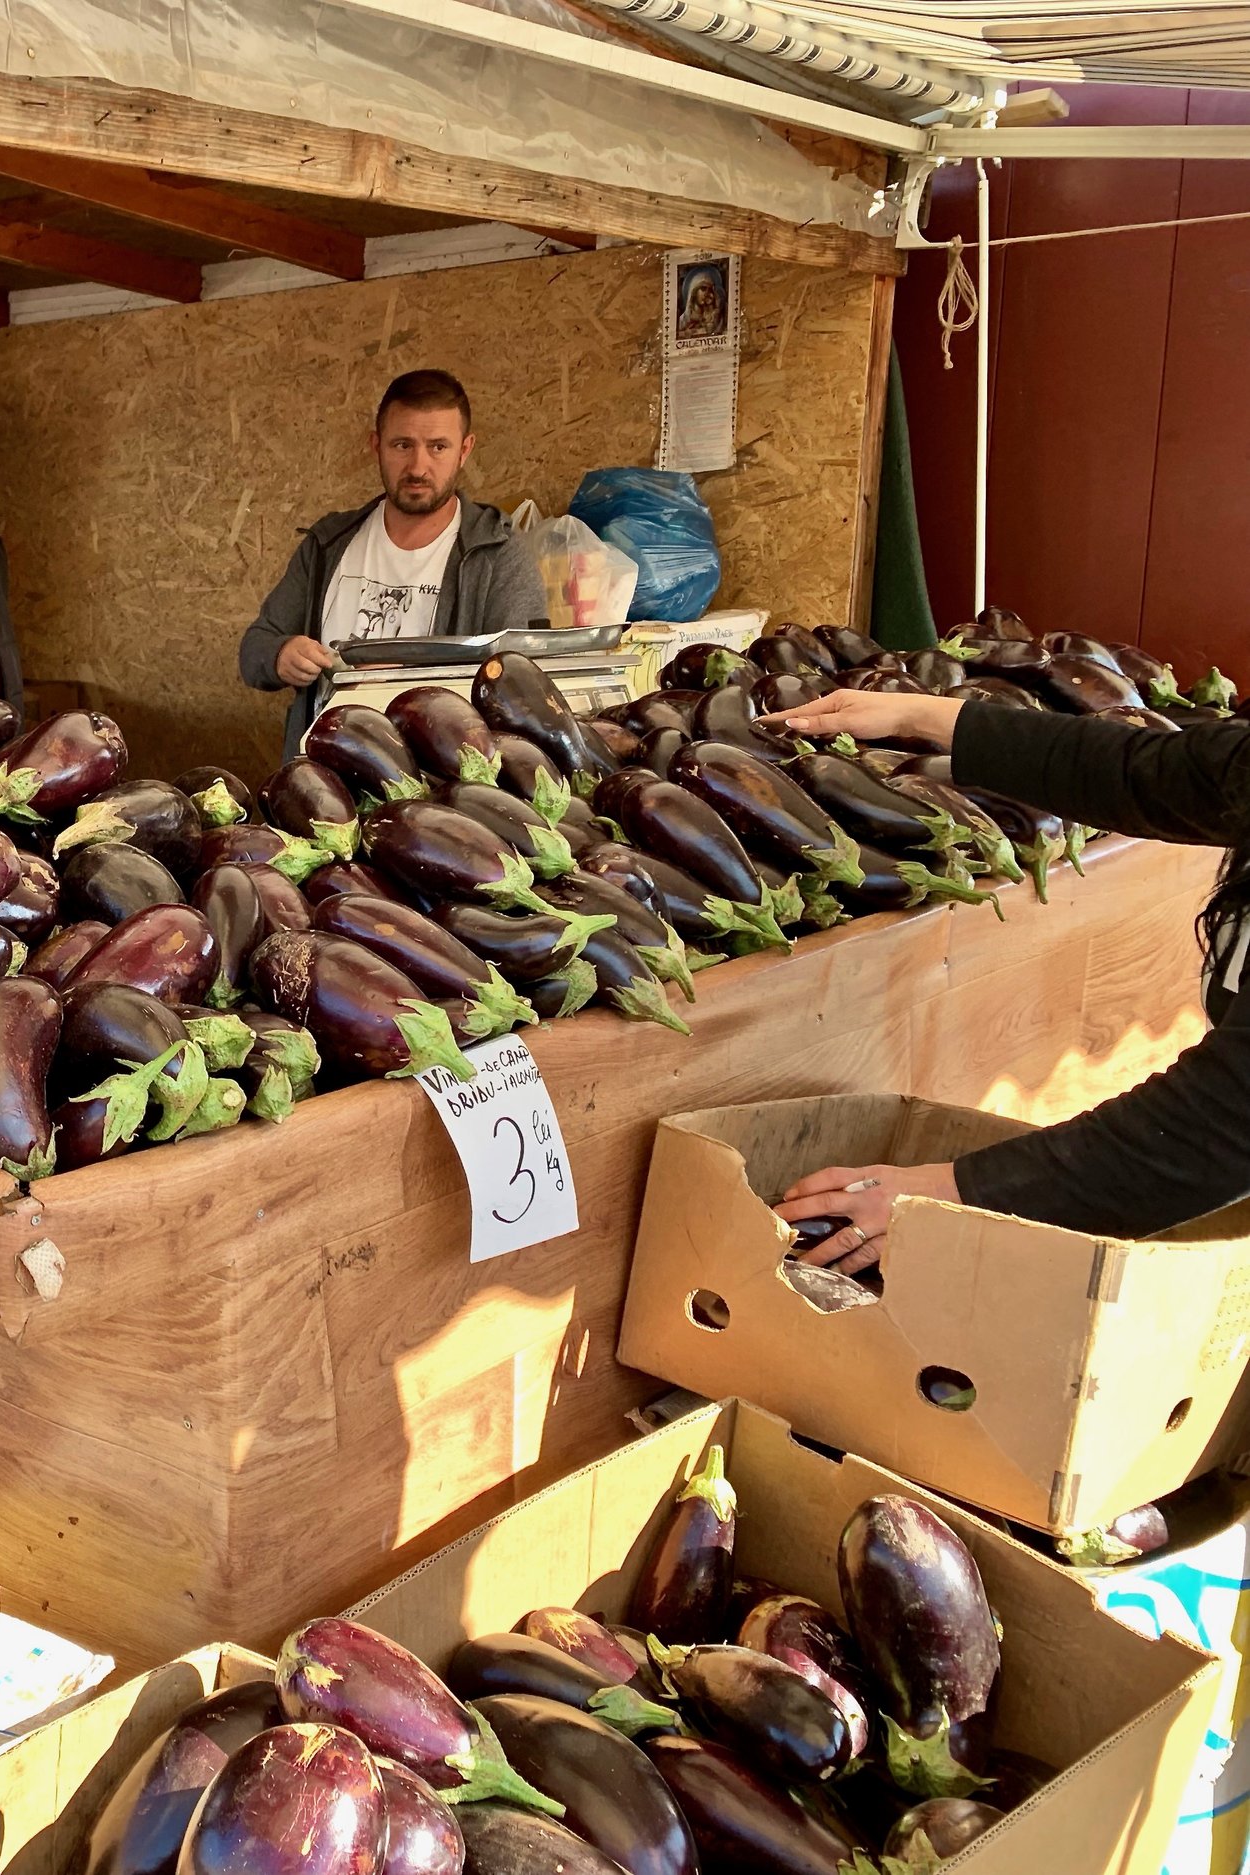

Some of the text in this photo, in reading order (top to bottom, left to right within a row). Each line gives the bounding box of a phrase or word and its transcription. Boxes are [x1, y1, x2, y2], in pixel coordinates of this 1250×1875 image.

[675, 335, 727, 350] CALENDAR
[492, 1108, 553, 1224] 3 lei
